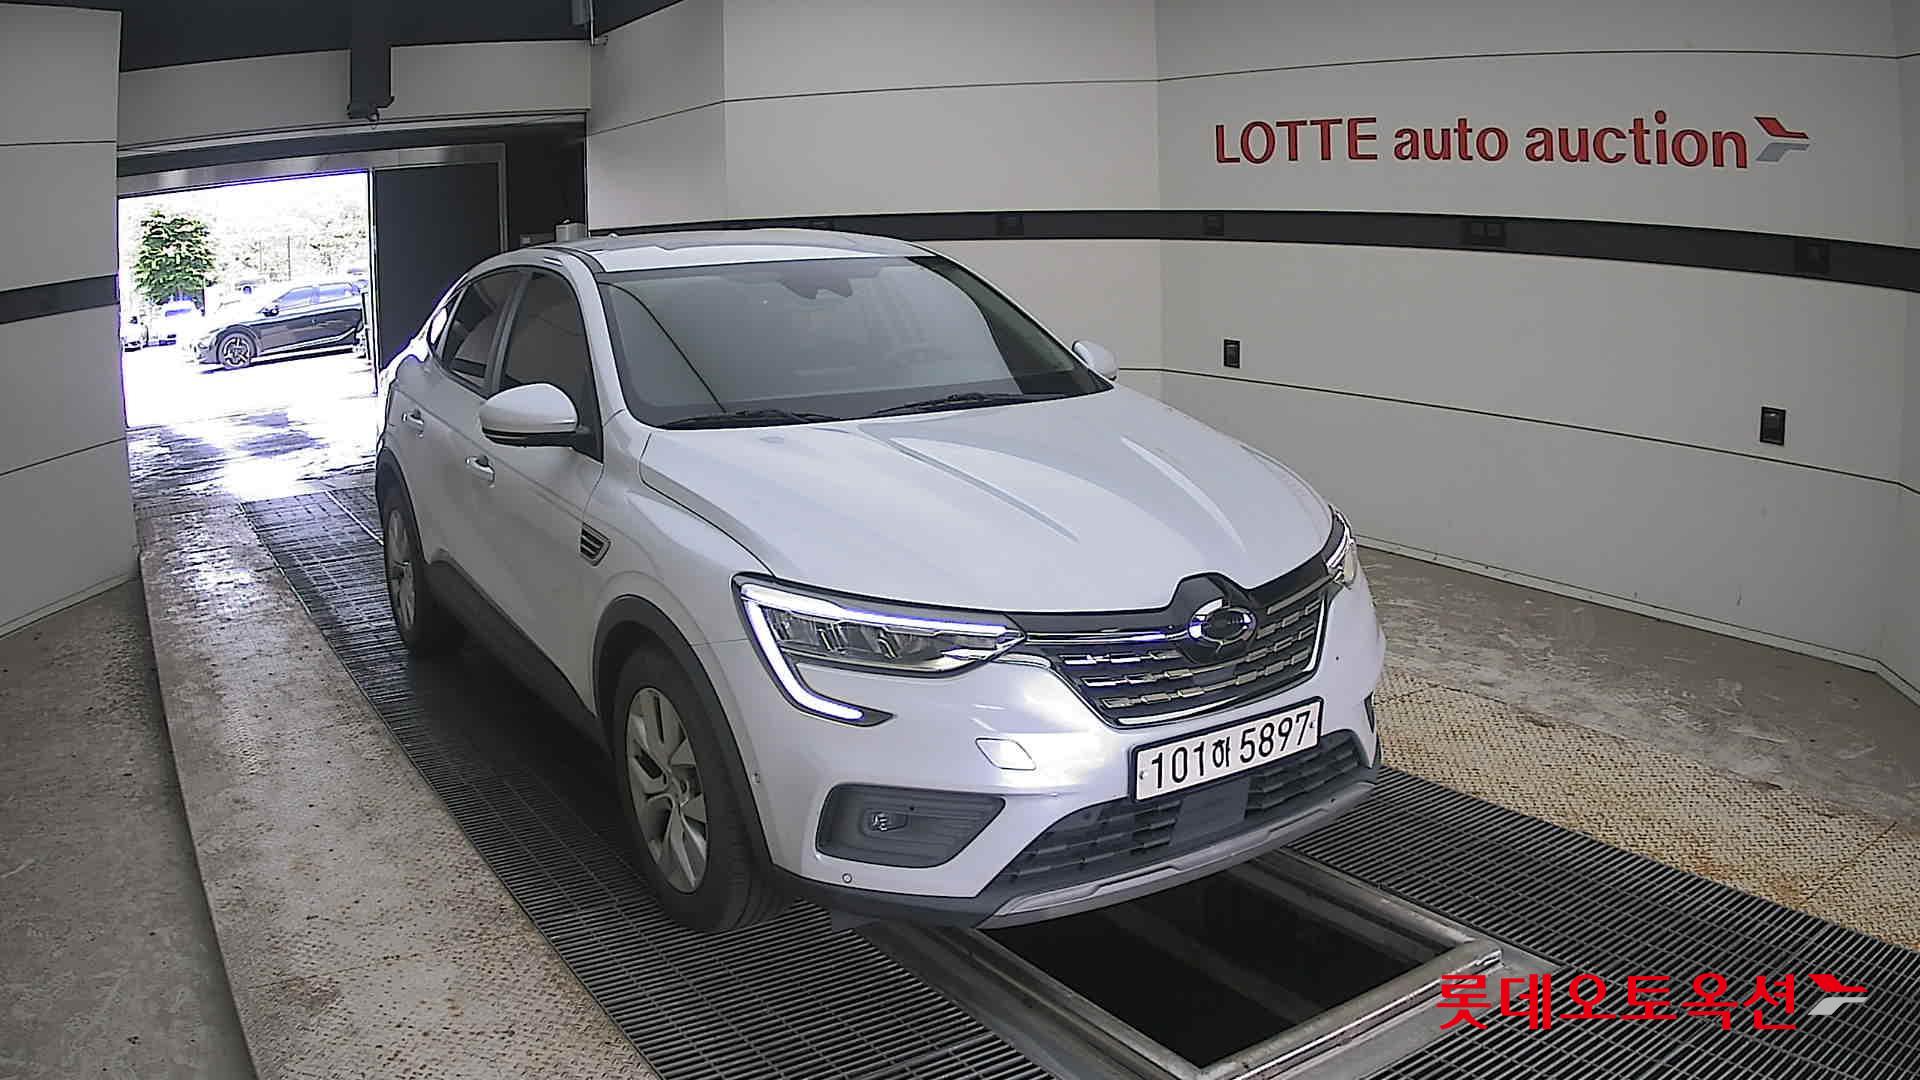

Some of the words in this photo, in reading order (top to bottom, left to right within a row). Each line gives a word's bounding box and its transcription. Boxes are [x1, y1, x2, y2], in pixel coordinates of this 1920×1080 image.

[1215, 117, 1378, 165] LOTTE
[1393, 118, 1508, 162] auto
[1525, 110, 1749, 169] auction
[1151, 736, 1231, 789] 101하
[1239, 711, 1311, 763] 5897
